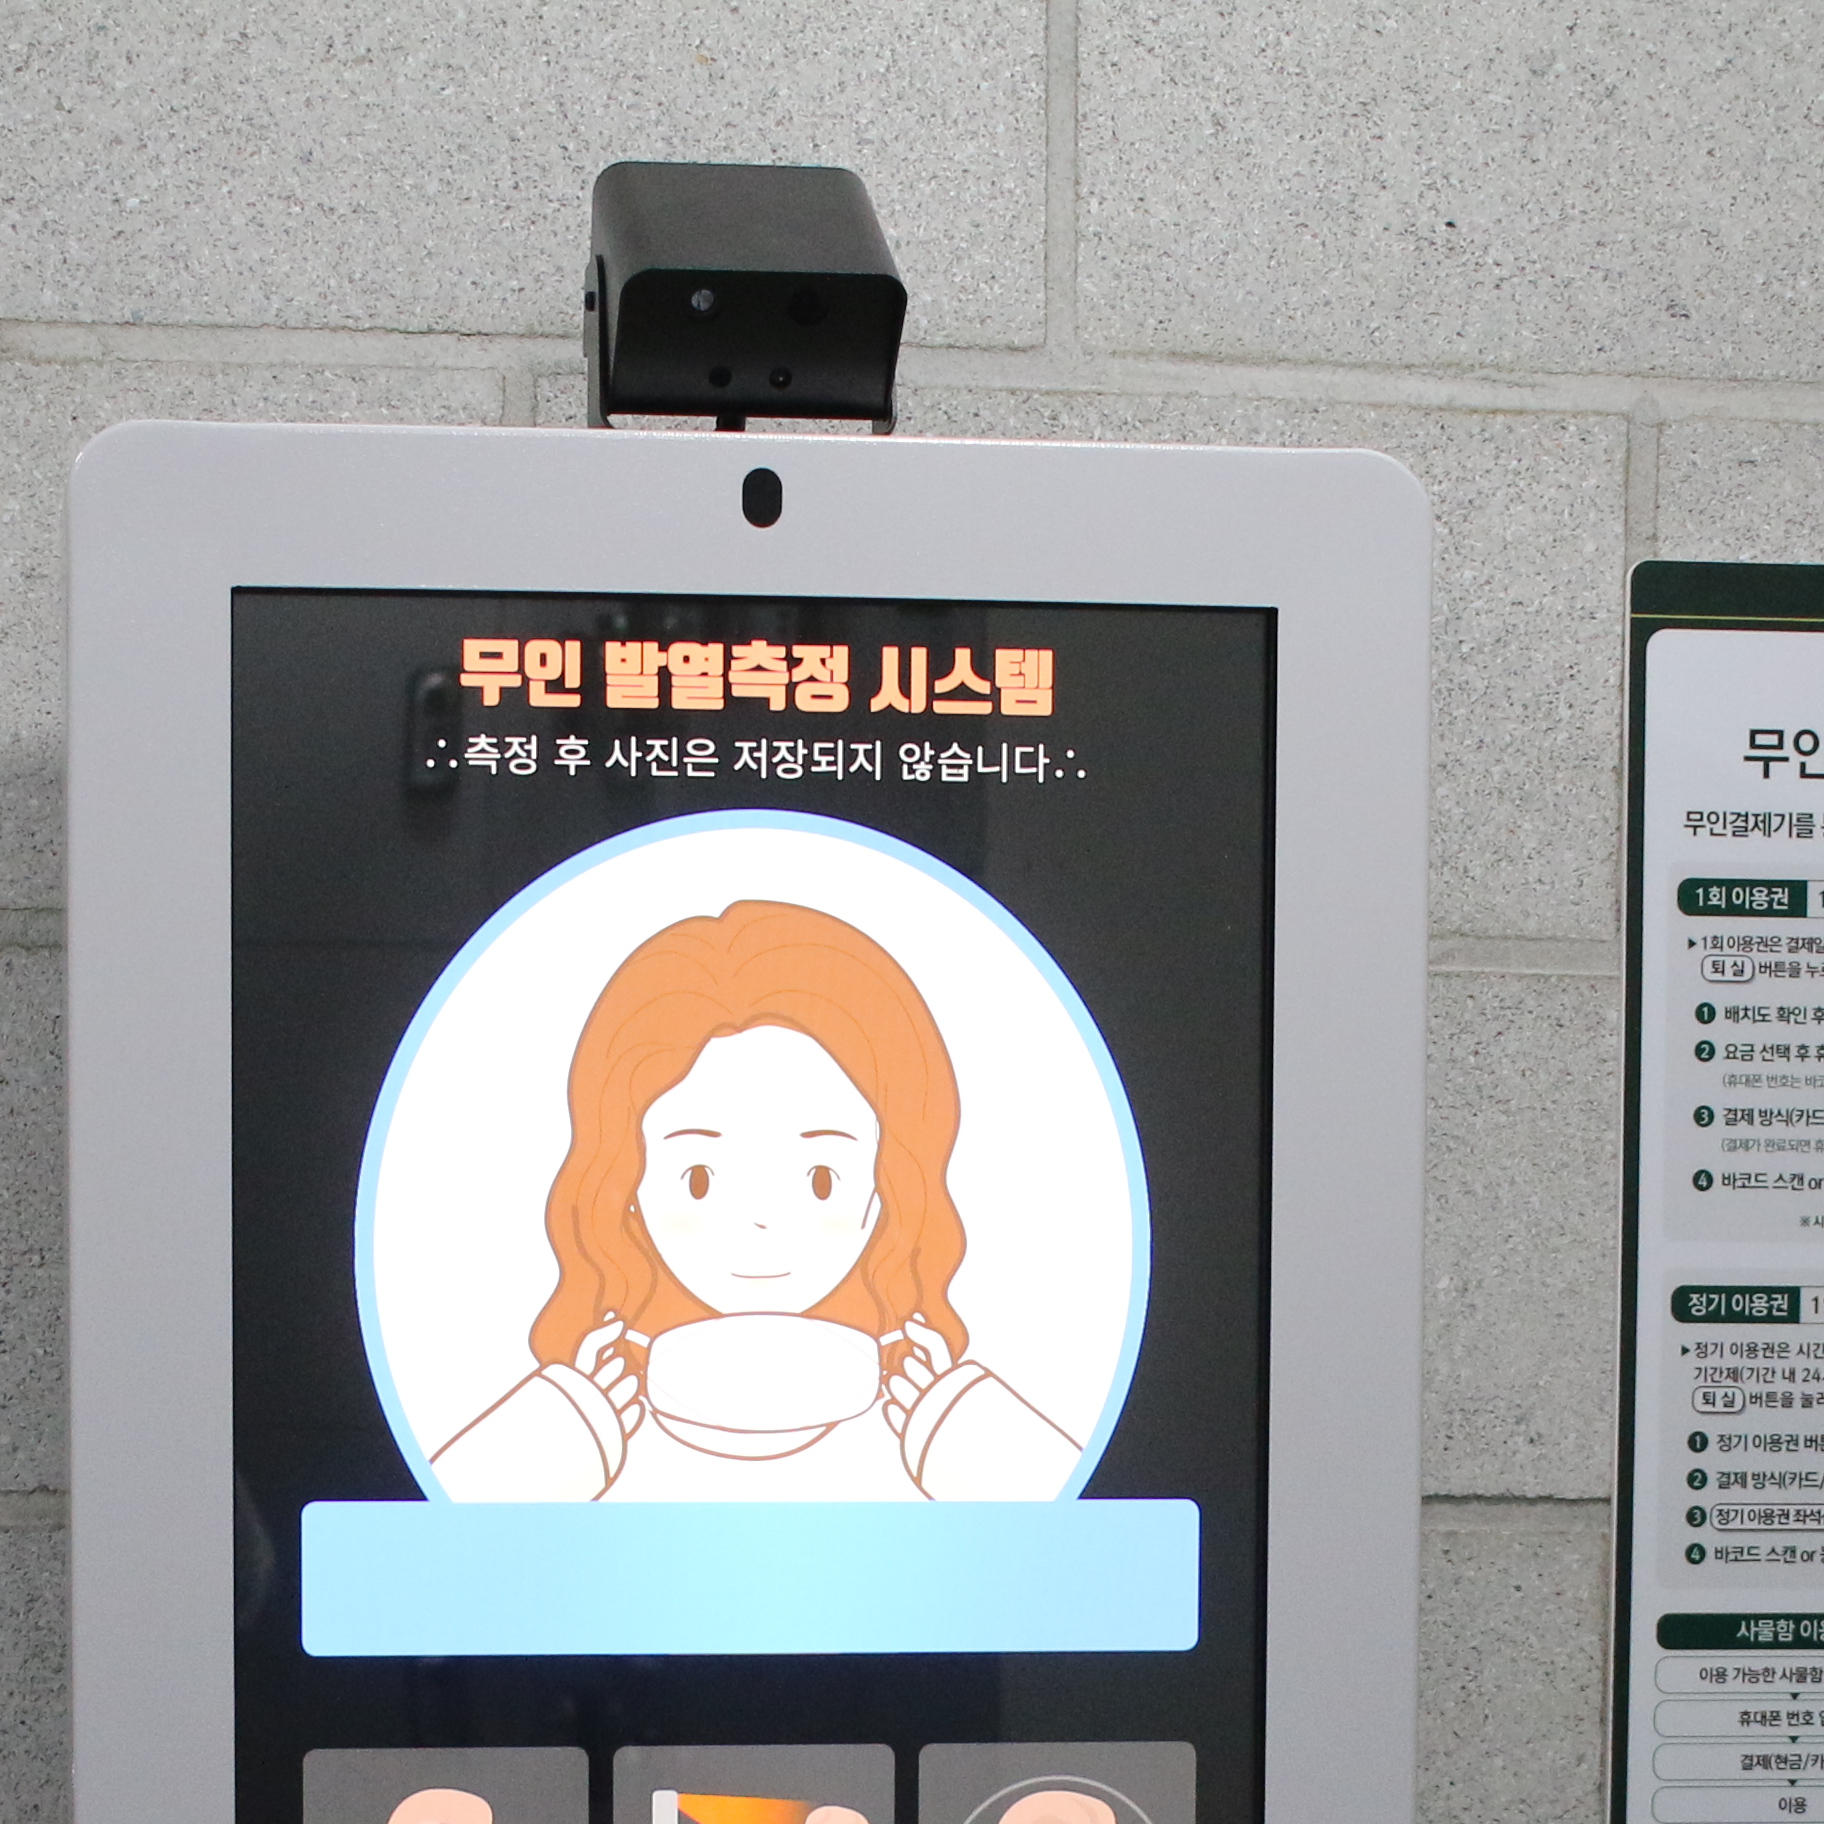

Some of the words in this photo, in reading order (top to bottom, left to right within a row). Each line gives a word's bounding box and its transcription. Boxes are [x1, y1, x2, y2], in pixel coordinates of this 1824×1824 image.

[459, 638, 582, 707] 무인
[604, 640, 850, 713] 발열측정
[870, 646, 1054, 716] 시스템
[554, 735, 591, 776] 후
[604, 736, 719, 779] 사진은
[733, 738, 883, 782] 저장되지
[1683, 810, 1816, 839] 무인결제기를
[1695, 886, 1726, 909] 1회
[1732, 886, 1789, 910] 이용권
[1724, 1006, 1771, 1024] 배치도
[1775, 1007, 1808, 1024] 확인
[1688, 1293, 1726, 1316] 정기
[1731, 1293, 1789, 1317] 이용권
[1736, 1619, 1795, 1642] 사물함
[1699, 1667, 1728, 1683] 이용
[1732, 1667, 1776, 1683] 가능한
[1779, 1667, 1823, 1683] 사물함
[1738, 1710, 1782, 1727] 휴대폰
[1786, 1710, 1815, 1727] 번호
[1778, 1797, 1807, 1814] 이용
